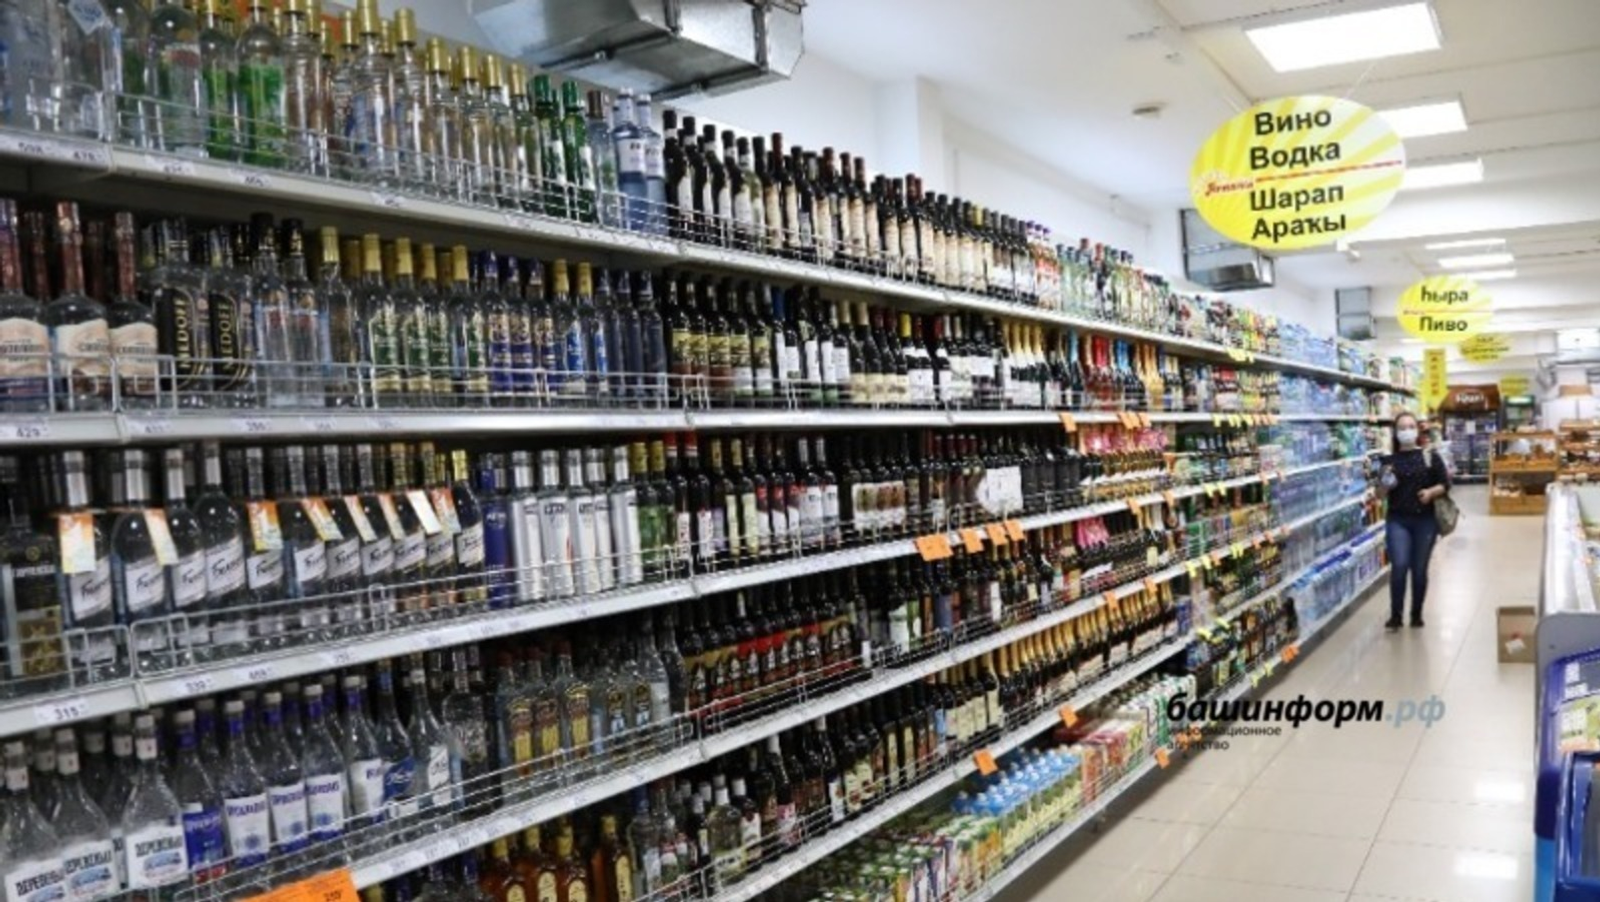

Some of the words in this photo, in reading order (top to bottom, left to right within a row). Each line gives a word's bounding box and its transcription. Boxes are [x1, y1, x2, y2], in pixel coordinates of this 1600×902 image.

[1255, 109, 1331, 136] Вино
[1250, 142, 1340, 170] Водка
[1250, 185, 1344, 212] Шарап
[1418, 316, 1468, 332] Пиво
